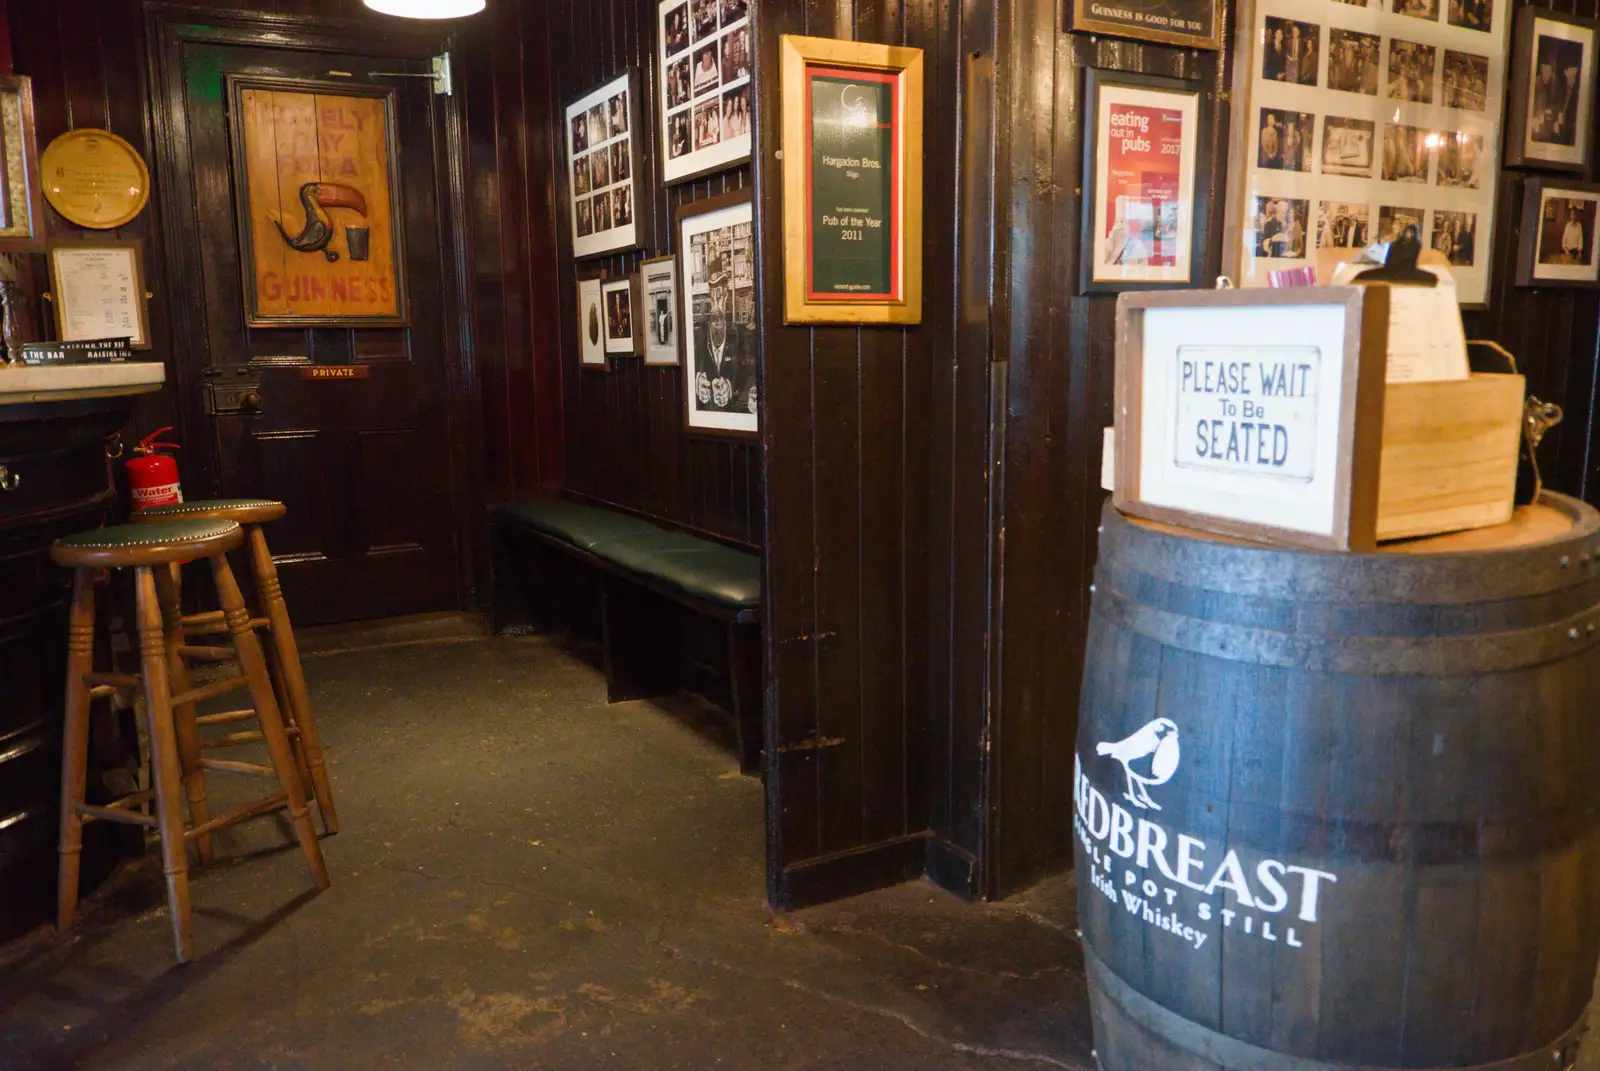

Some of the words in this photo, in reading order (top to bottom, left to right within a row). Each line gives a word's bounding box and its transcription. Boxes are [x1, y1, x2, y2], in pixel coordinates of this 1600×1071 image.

[1090, 3, 1133, 20] GUINNESS
[1134, 12, 1144, 22] IS
[1145, 15, 1169, 27] GOOD
[1170, 18, 1186, 29] FOR
[1187, 20, 1203, 31] YOU
[1111, 111, 1150, 133] eating
[1111, 128, 1125, 138] out
[1126, 128, 1135, 139] in
[1122, 136, 1152, 155] pubs
[1161, 143, 1180, 156] 2017
[341, 157, 358, 176] A
[823, 155, 860, 169] Hargadon
[862, 157, 882, 168] Bros.
[823, 215, 839, 226] Pub
[840, 216, 849, 226] of
[851, 217, 863, 227] the
[865, 217, 882, 228] Year
[841, 230, 863, 241] 2011
[261, 272, 391, 303] GUINNESS
[29, 351, 44, 359] THE
[47, 351, 65, 359] BAR
[1182, 360, 1252, 395] PLEASE
[1258, 362, 1312, 398] WAIT
[1218, 398, 1237, 417] To
[1242, 400, 1265, 420] Be
[1195, 419, 1288, 467] SEATED
[137, 487, 172, 497] Water
[1090, 864, 1118, 905] Irish
[1121, 889, 1210, 950] Whiskey
[1124, 870, 1178, 907] POT
[1197, 902, 1304, 949] STILL
